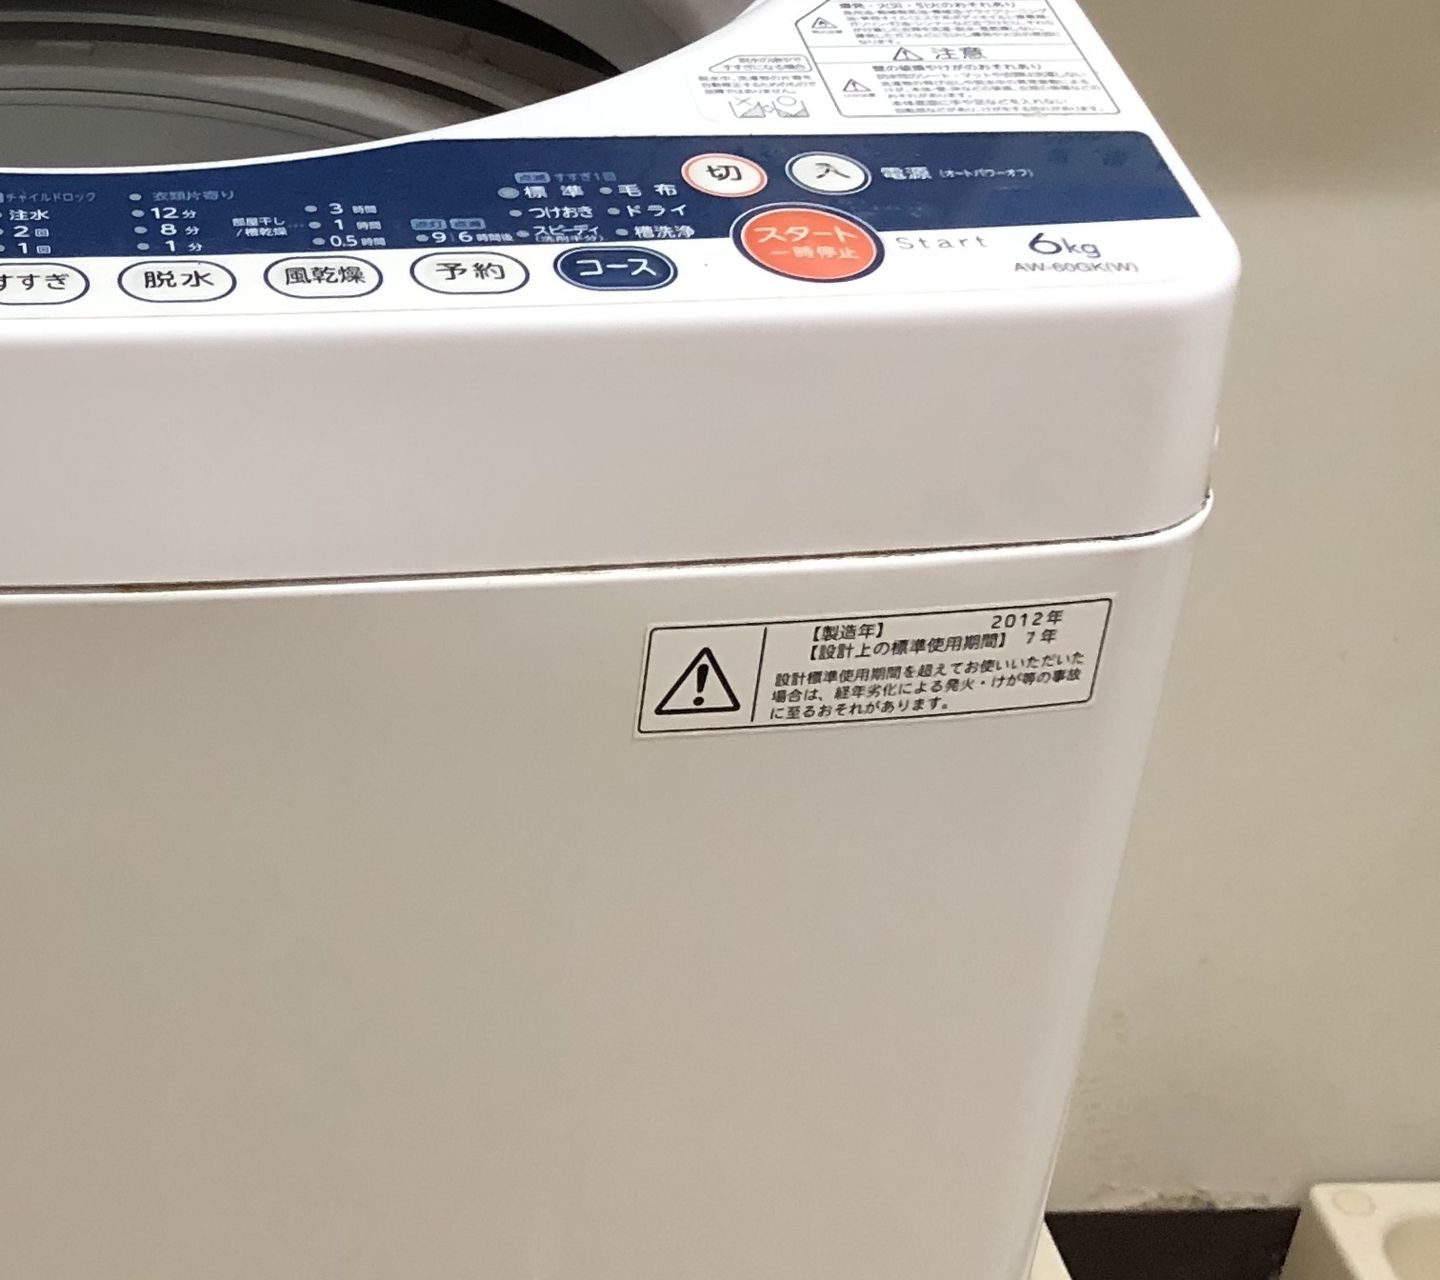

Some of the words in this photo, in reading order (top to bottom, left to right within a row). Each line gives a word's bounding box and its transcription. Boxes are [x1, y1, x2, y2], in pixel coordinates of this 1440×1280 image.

[931, 47, 988, 60] 注意
[706, 164, 742, 181] 切
[815, 162, 851, 180] 入
[881, 166, 931, 180] 電源
[524, 185, 585, 199] 標準
[618, 183, 678, 197] 毛布
[9, 209, 50, 221] 注水
[528, 205, 593, 219] つけおき
[626, 204, 687, 217] ドライ
[754, 225, 857, 244] スタート
[896, 236, 987, 250] Start
[770, 245, 859, 260] 一時停止
[1029, 233, 1101, 258] 6kg
[285, 267, 365, 285] 風乾燥
[435, 262, 505, 280] 予約
[576, 258, 657, 276] コース
[1014, 262, 1139, 272] AW-60GK(W)
[144, 270, 215, 289] 脱水
[812, 622, 883, 642] 【製造年】
[991, 610, 1063, 630] 2012年
[810, 632, 1006, 661] 【設計上の標準使用期間】
[770, 696, 948, 719] に至るおそれがあります。
